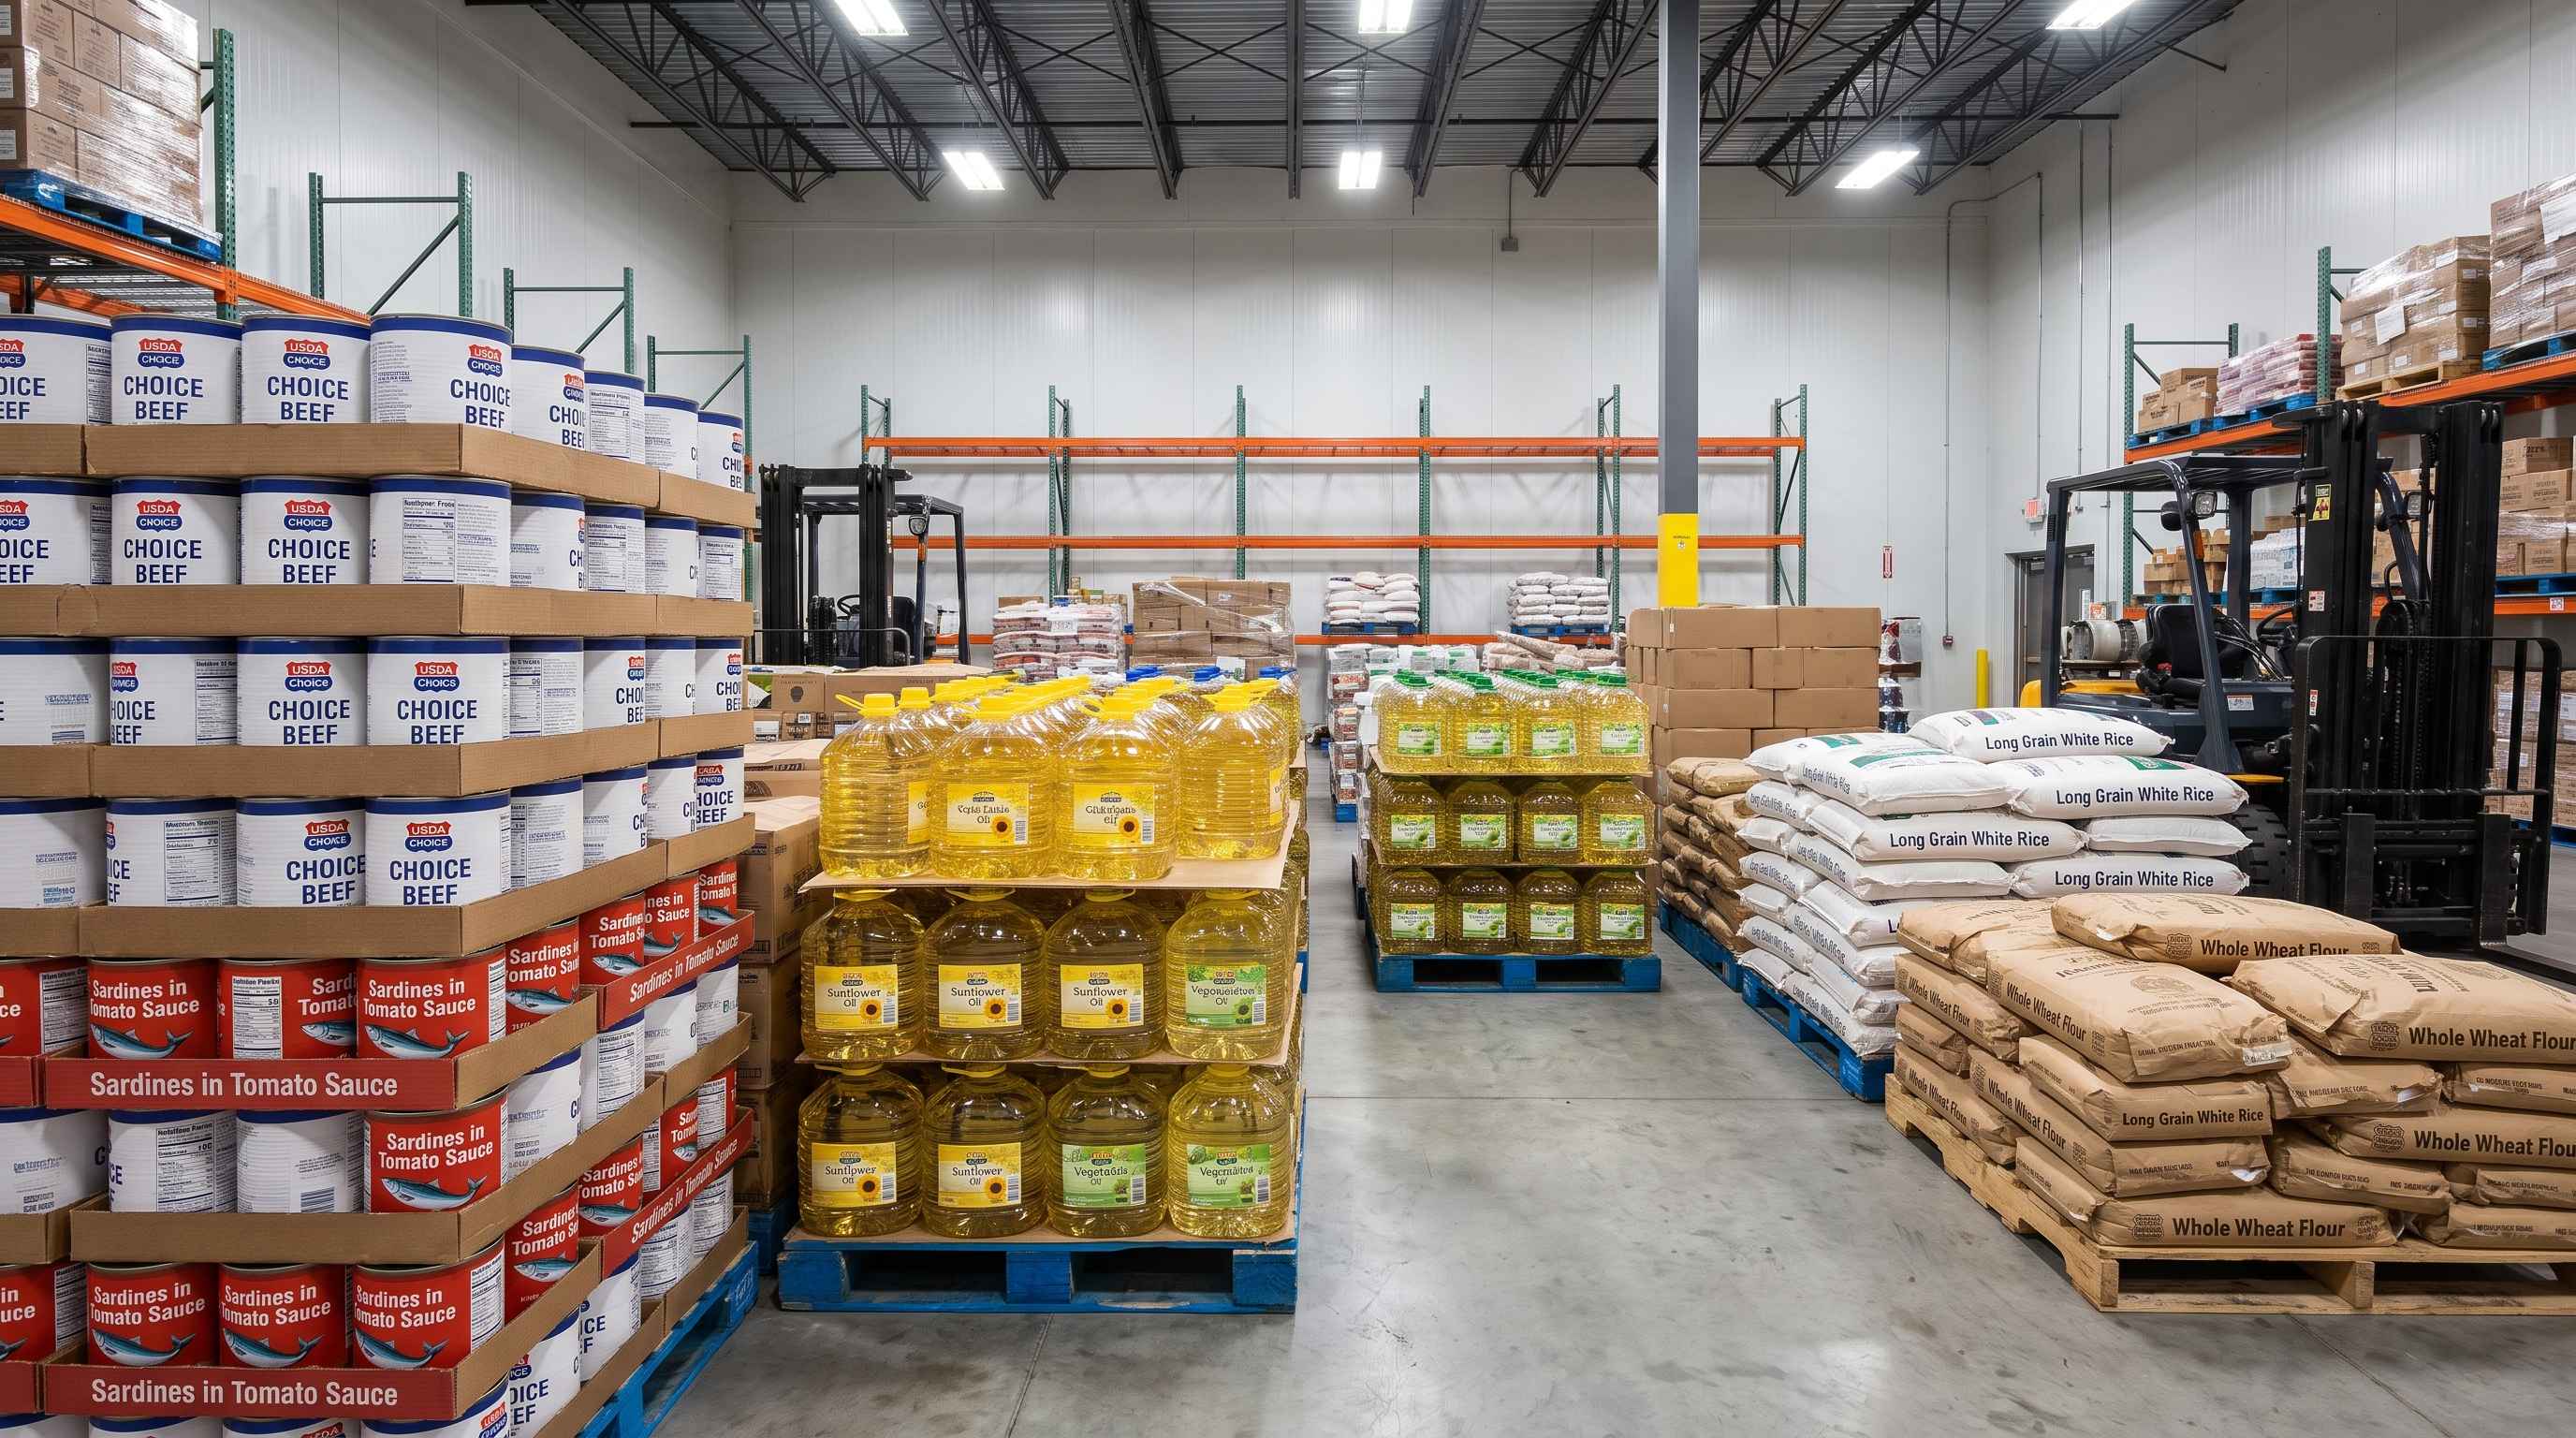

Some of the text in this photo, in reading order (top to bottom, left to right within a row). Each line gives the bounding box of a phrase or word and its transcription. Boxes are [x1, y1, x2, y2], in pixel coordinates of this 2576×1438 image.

[143, 342, 178, 352] USDA
[290, 343, 324, 354] USDA
[0, 376, 46, 397] OICE
[124, 376, 203, 398] CHOICE
[267, 376, 349, 401] CHOICE
[450, 378, 510, 407] CHOICE
[136, 401, 188, 420] BEEF
[281, 402, 335, 422] BEEF
[465, 405, 505, 429] BEEF
[562, 429, 585, 449] BEE
[0, 506, 22, 514] SDA
[143, 505, 175, 514] USDA
[291, 505, 324, 514] USDA
[288, 518, 329, 527] CHOICE
[0, 538, 49, 559] OICE
[124, 538, 202, 559] CHOICE
[268, 538, 350, 560] CHOICE
[0, 564, 35, 584] EEF
[136, 564, 187, 584] BEEF
[283, 564, 337, 584] BEEF
[292, 665, 326, 676] USDA
[416, 665, 453, 676] USDA
[111, 700, 155, 721] HOICE
[268, 699, 351, 721] CHOICE
[397, 699, 477, 721] CHOICE
[283, 725, 338, 745] BEEF
[411, 725, 465, 745] BEEF
[1985, 732, 2134, 752] Long Grain White Rice
[696, 790, 734, 807] HOICE
[2056, 786, 2214, 808] Long Grain White Rice
[311, 824, 344, 834] USDA
[411, 825, 446, 835] USDA
[409, 837, 448, 847] CHOICE
[1890, 830, 2050, 850] Long Grain White Rice
[286, 854, 366, 881] CHOICE
[389, 858, 472, 881] CHOICE
[2055, 871, 2214, 889] Long Grain White Rice
[302, 880, 356, 905] BEEF
[402, 884, 458, 905] BEEF
[673, 892, 683, 905] in
[657, 907, 690, 923] Sauce
[509, 943, 571, 965] Sardines
[2201, 939, 2249, 957] Whole
[2254, 941, 2305, 958] Wheat
[630, 933, 739, 1003] Sardines in Tomato Sauce
[94, 979, 187, 1000] Sardines in
[369, 978, 465, 1000] Sardines in
[1073, 987, 1127, 997] Sunflower
[142, 999, 199, 1019] Sauce
[363, 996, 476, 1019] Tomato Sauce
[2006, 982, 2031, 1009] Whole
[2063, 1015, 2086, 1042] Flour
[2408, 1027, 2465, 1047] Whole
[2469, 1029, 2527, 1049] Wheat
[2532, 1031, 2576, 1050] Flour
[91, 1071, 398, 1096] Sardines in Tomato Sauce
[2122, 1108, 2263, 1129] Long Grain White Rice
[388, 1124, 484, 1152] Sardines in
[2042, 1118, 2067, 1150] Flour
[2414, 1130, 2470, 1152] Whole
[2475, 1134, 2534, 1155] Wheat
[2538, 1137, 2576, 1158] Flou
[378, 1140, 493, 1170] Tomato Sauce
[583, 1160, 637, 1182] Sardines
[675, 1187, 684, 1207] in
[2173, 1218, 2231, 1237] Whole
[2235, 1218, 2293, 1237] Wheat
[2299, 1219, 2347, 1237] Flour
[512, 1230, 565, 1256] Tomato
[1, 1287, 19, 1303] in
[95, 1282, 191, 1306] Sardines in
[226, 1284, 316, 1307] Sardines in
[357, 1285, 443, 1309] Sardines in
[91, 1298, 205, 1326] Tomato Sauce
[222, 1300, 331, 1327] Tomato Sauce
[401, 1306, 456, 1328] Sauce
[92, 1378, 398, 1406] Sardines in Tomato Sauce
